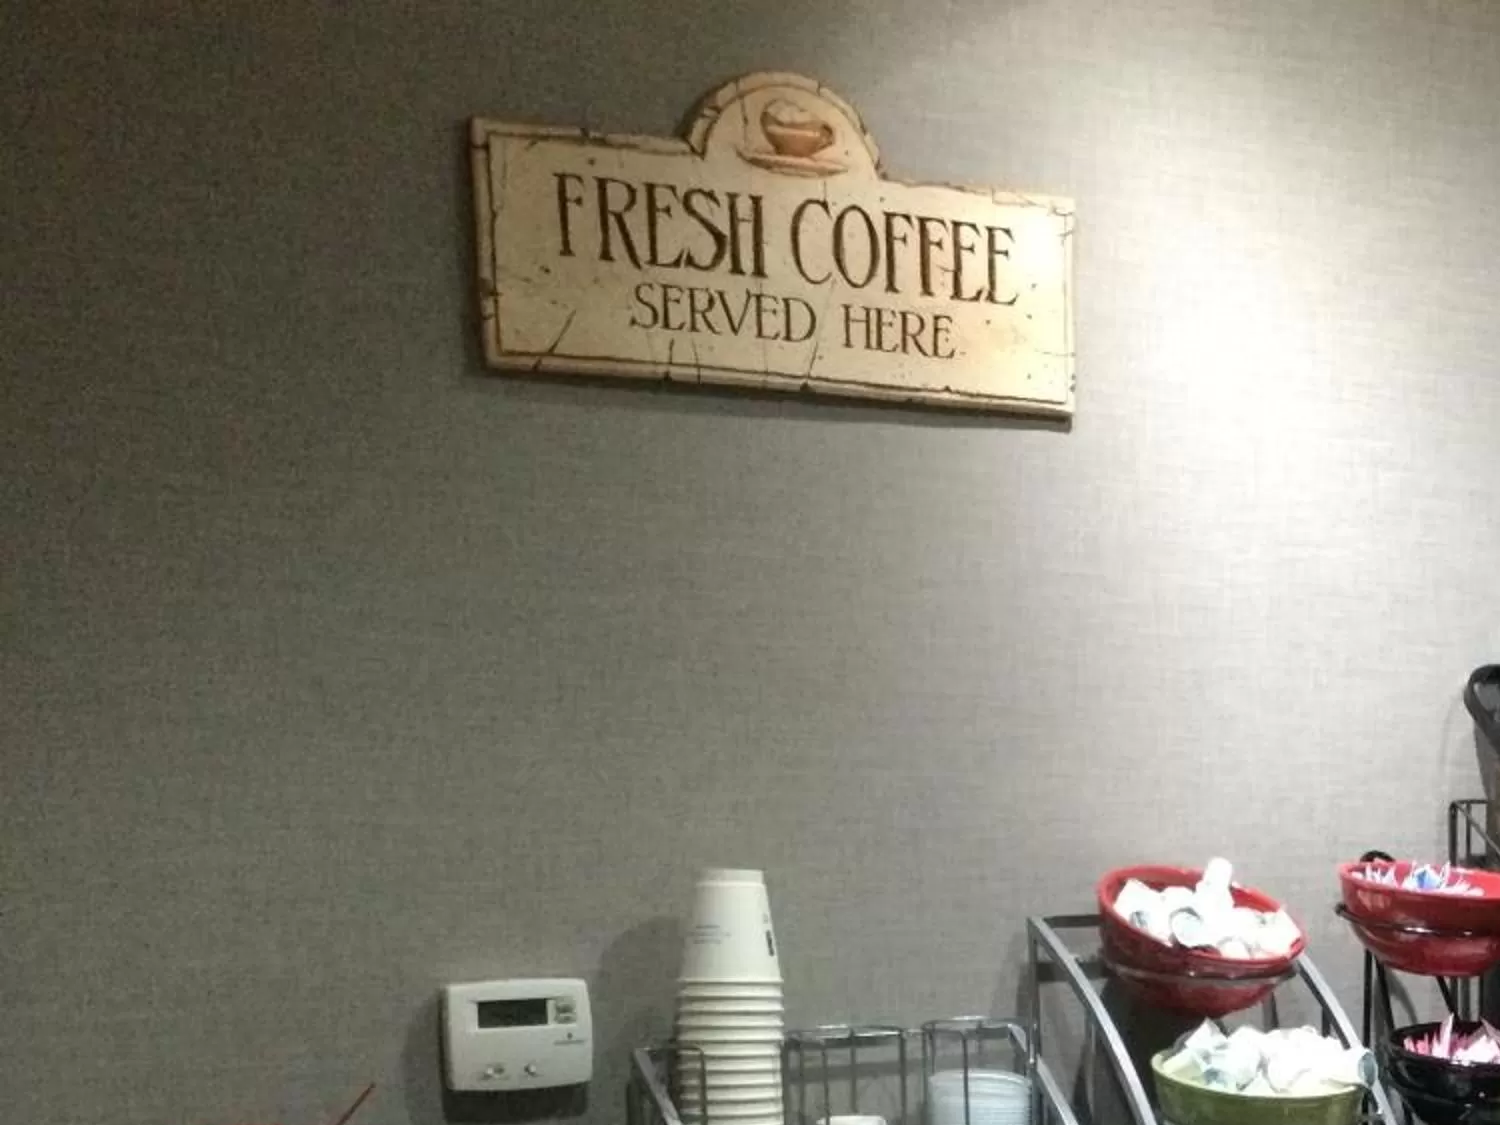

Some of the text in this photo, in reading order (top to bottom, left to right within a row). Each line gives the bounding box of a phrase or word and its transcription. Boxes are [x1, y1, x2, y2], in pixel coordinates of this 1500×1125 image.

[552, 171, 1019, 306] FRESH COFFEE
[630, 282, 957, 361] SERVED HERE
